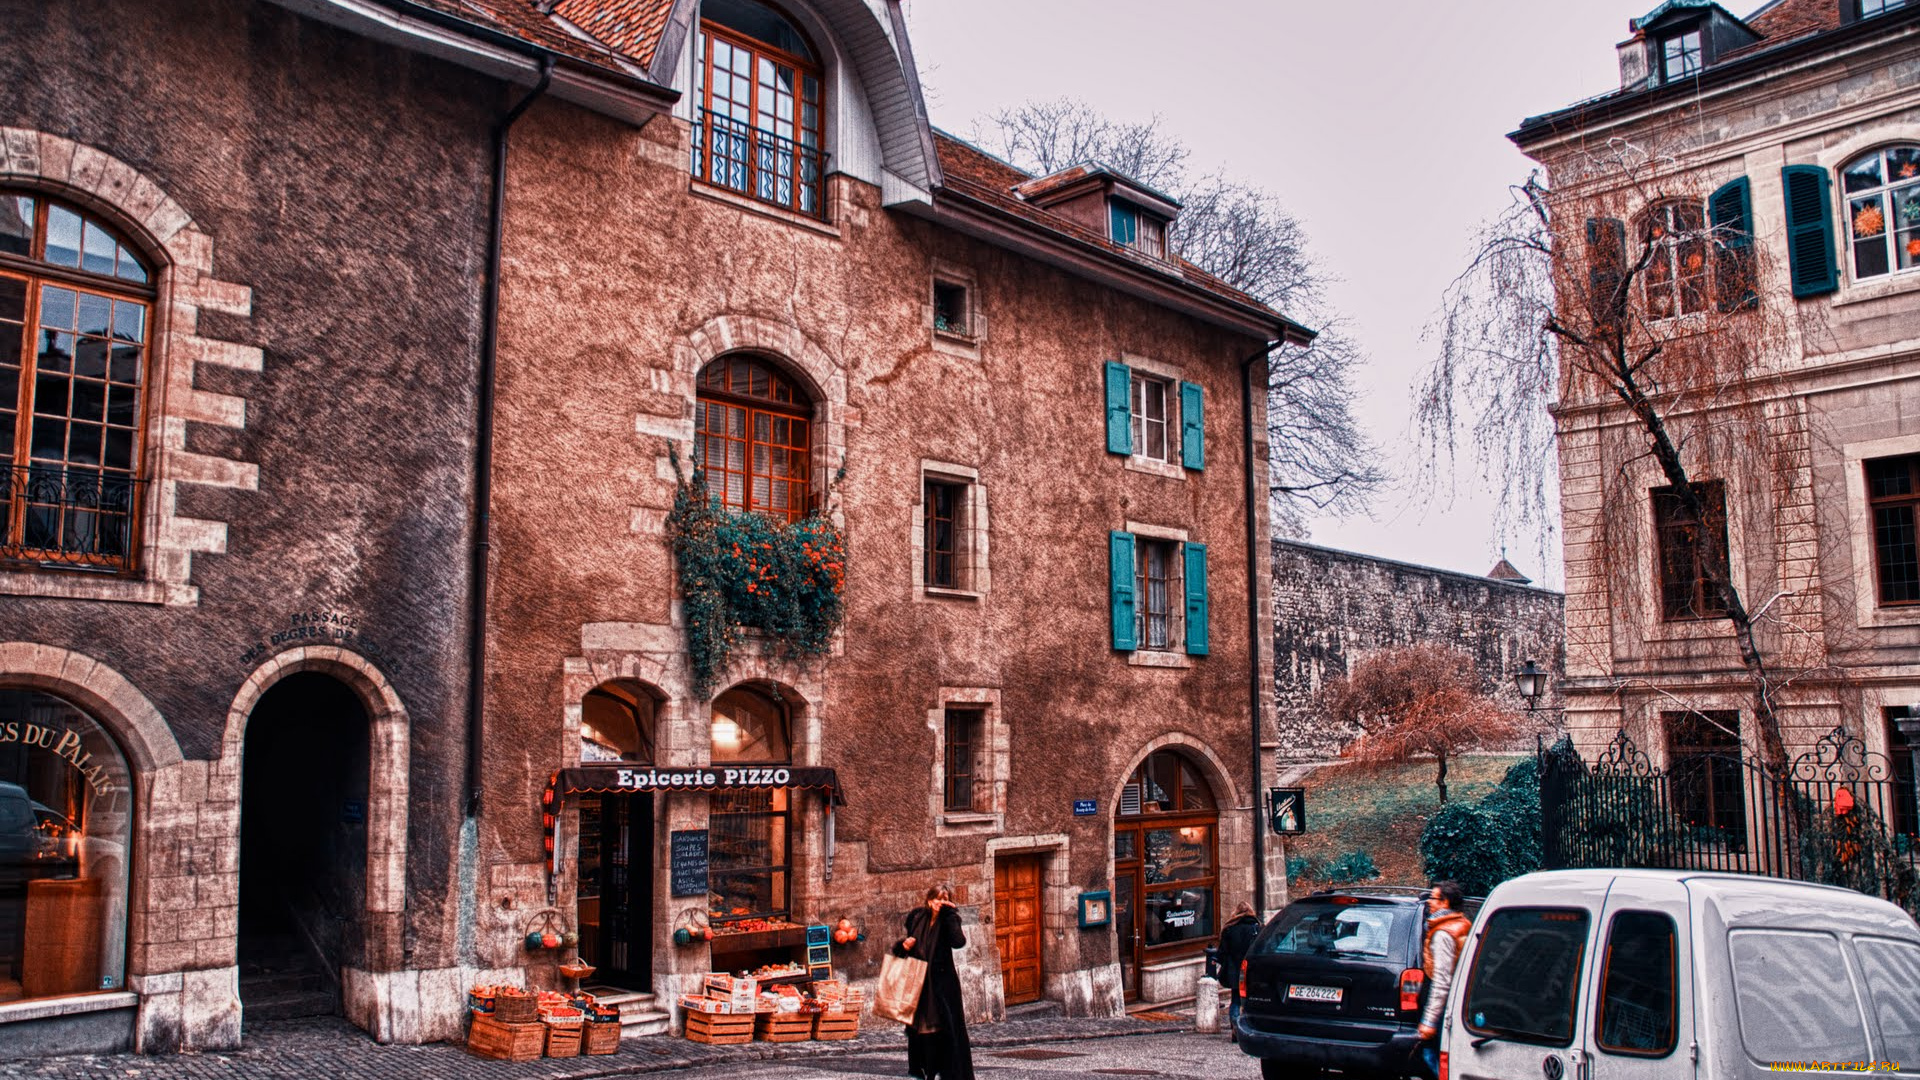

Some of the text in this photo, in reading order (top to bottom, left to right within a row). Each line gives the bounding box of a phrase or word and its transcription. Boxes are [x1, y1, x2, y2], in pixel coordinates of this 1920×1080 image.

[291, 612, 359, 628] PASSAGE
[239, 642, 266, 664] DES
[22, 723, 56, 748] DU
[53, 728, 115, 797] PALAIS
[617, 769, 790, 788] Epicerie PIZZO
